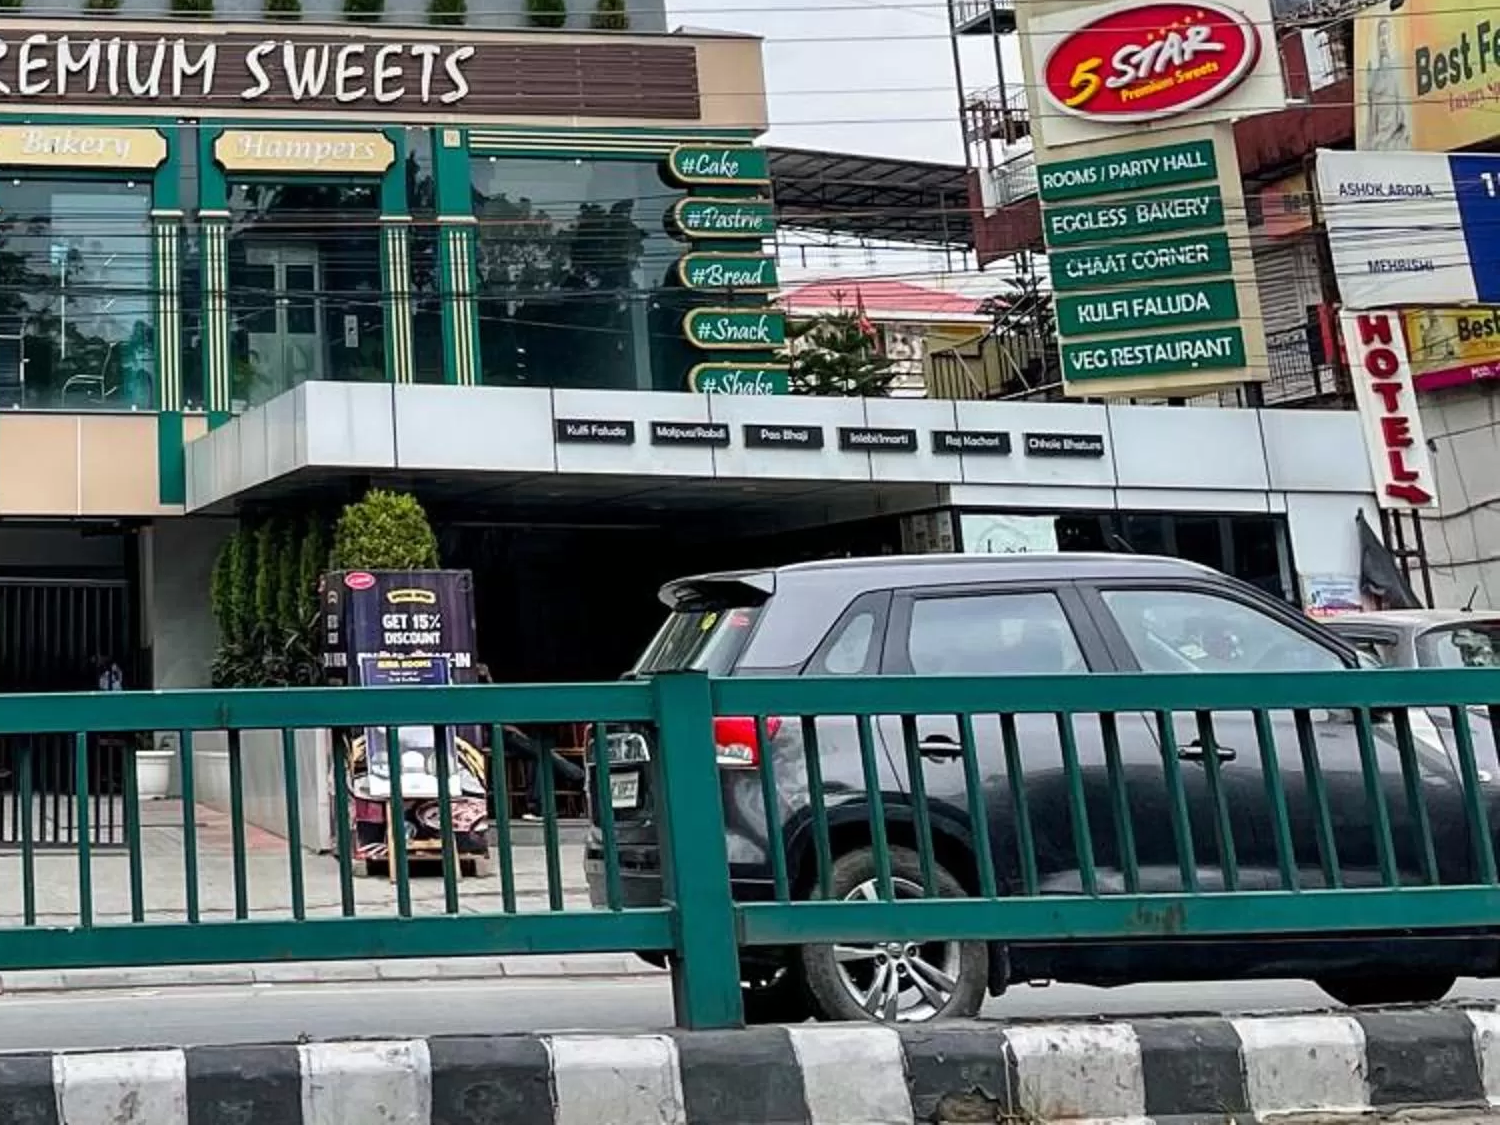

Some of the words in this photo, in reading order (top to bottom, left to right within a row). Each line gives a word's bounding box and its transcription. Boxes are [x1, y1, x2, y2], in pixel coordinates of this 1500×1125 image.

[241, 40, 476, 103] SWEETS
[1065, 57, 1102, 107] 5
[1105, 26, 1225, 88] STAR
[1415, 31, 1473, 96] Best
[1120, 77, 1175, 102] Premium
[1176, 60, 1219, 84] Sweets
[21, 129, 132, 159] Bakery
[237, 132, 375, 163] Hampers
[681, 151, 739, 178] #Cake
[1043, 167, 1097, 190] ROOMS
[1109, 158, 1160, 181] PARTY
[1163, 150, 1208, 172] HALL
[1339, 182, 1386, 196] ASHOK
[1387, 183, 1434, 197] ARORA
[1052, 207, 1127, 235] EGGLESS
[1136, 196, 1209, 224] BAKERY
[691, 260, 767, 286] #Bread
[1066, 253, 1127, 278] CHAAT
[1132, 244, 1209, 271] CORNER
[1077, 300, 1129, 324] KULFI
[1133, 291, 1210, 318] FALUDA
[697, 315, 770, 343] #Snack
[1070, 349, 1109, 371] VEG
[1111, 337, 1233, 366] RESTAURANT
[702, 370, 774, 395] #Shake
[1356, 314, 1419, 481] HOTEL
[591, 426, 627, 437] Faluda
[382, 614, 408, 629] GET
[412, 613, 441, 629] 15%
[384, 631, 441, 645] DISCOUNT
